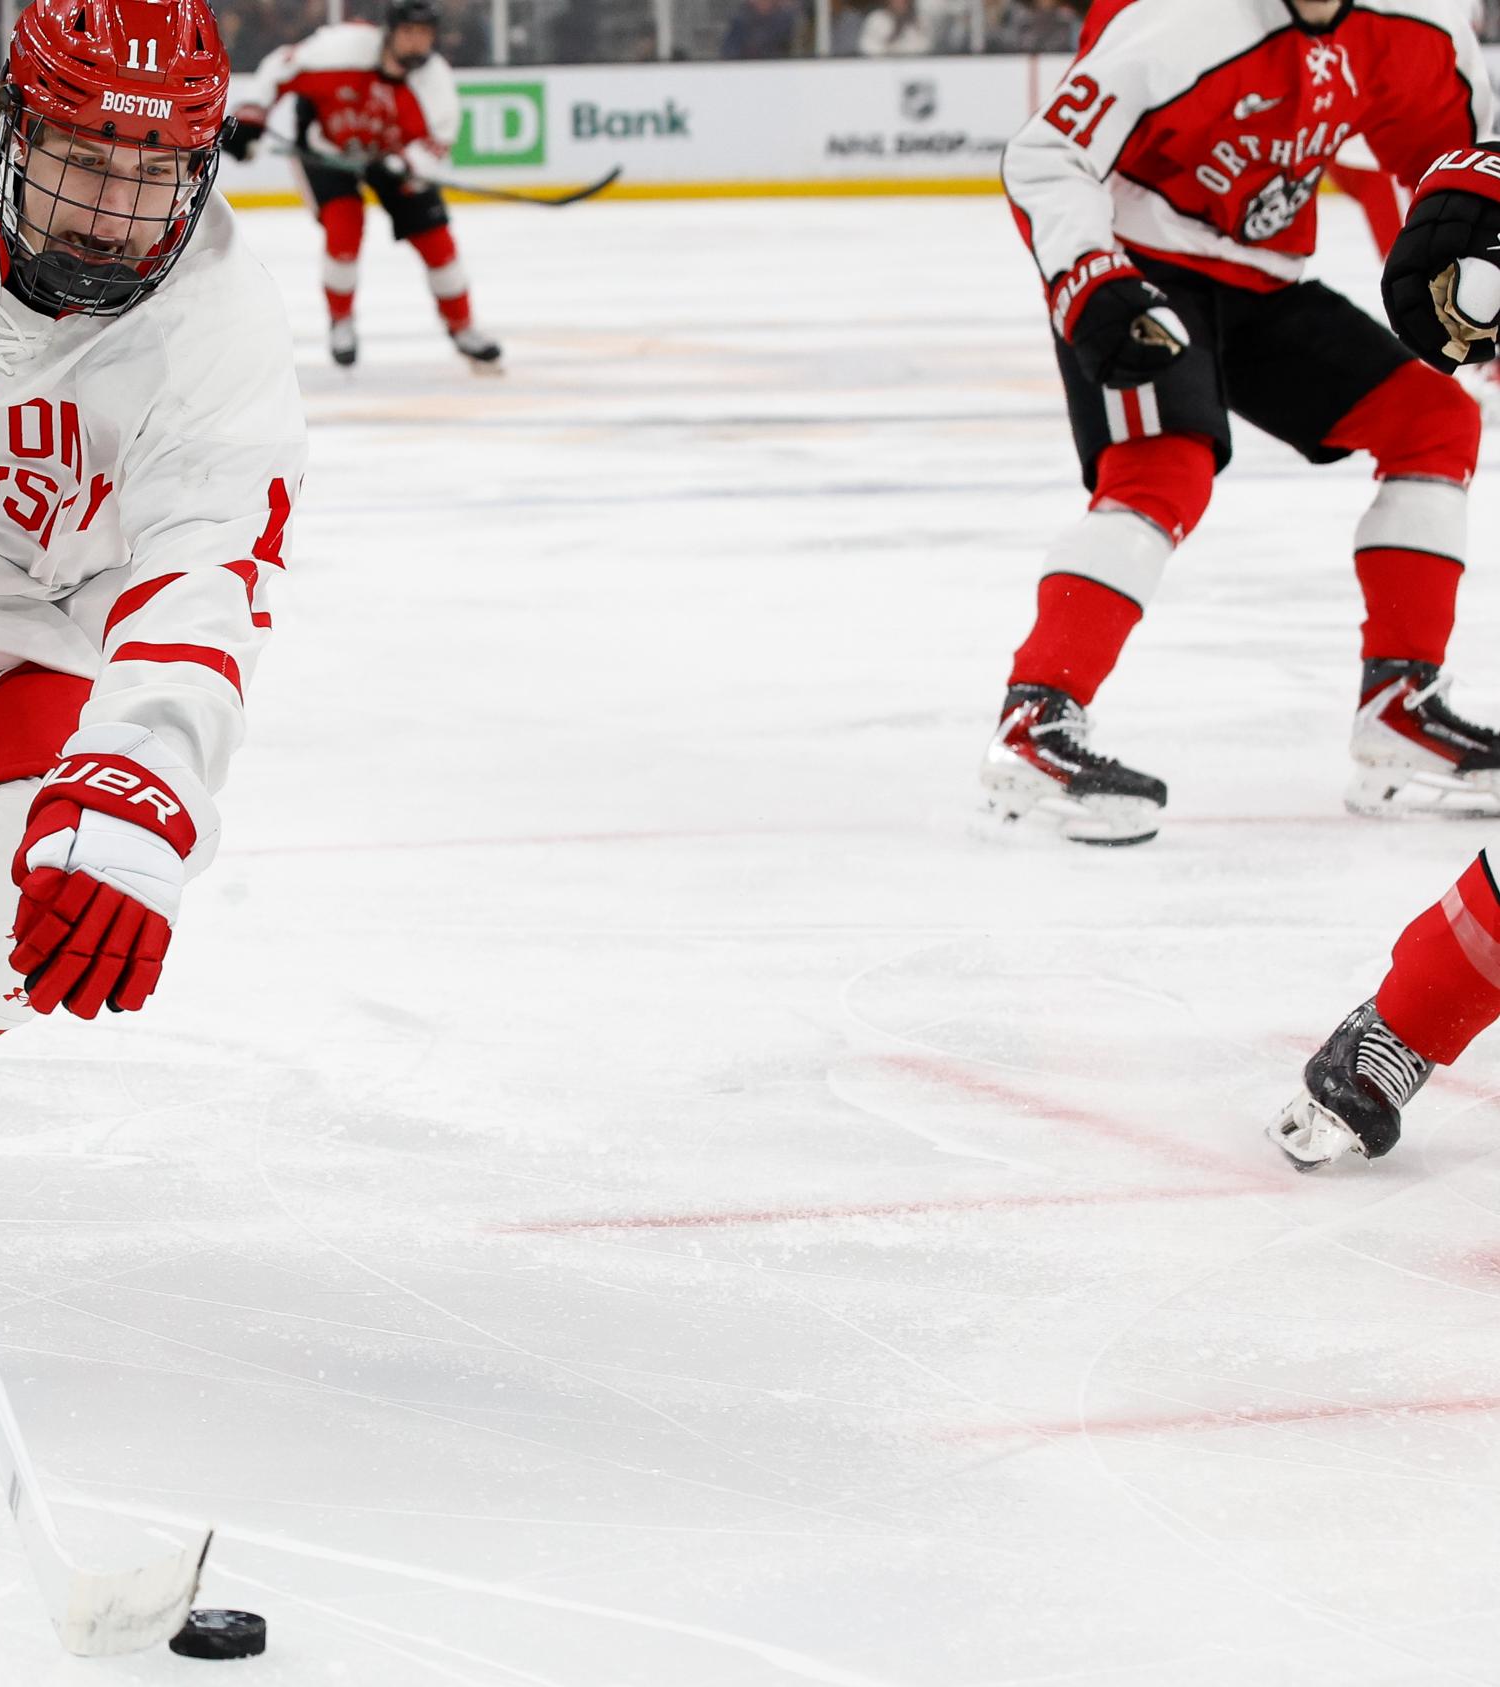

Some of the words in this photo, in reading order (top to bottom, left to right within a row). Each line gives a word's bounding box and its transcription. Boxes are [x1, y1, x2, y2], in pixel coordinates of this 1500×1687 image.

[126, 38, 158, 72] 11
[101, 90, 174, 119] BOSTON
[571, 99, 688, 139] Bank
[1043, 73, 1117, 149] 21
